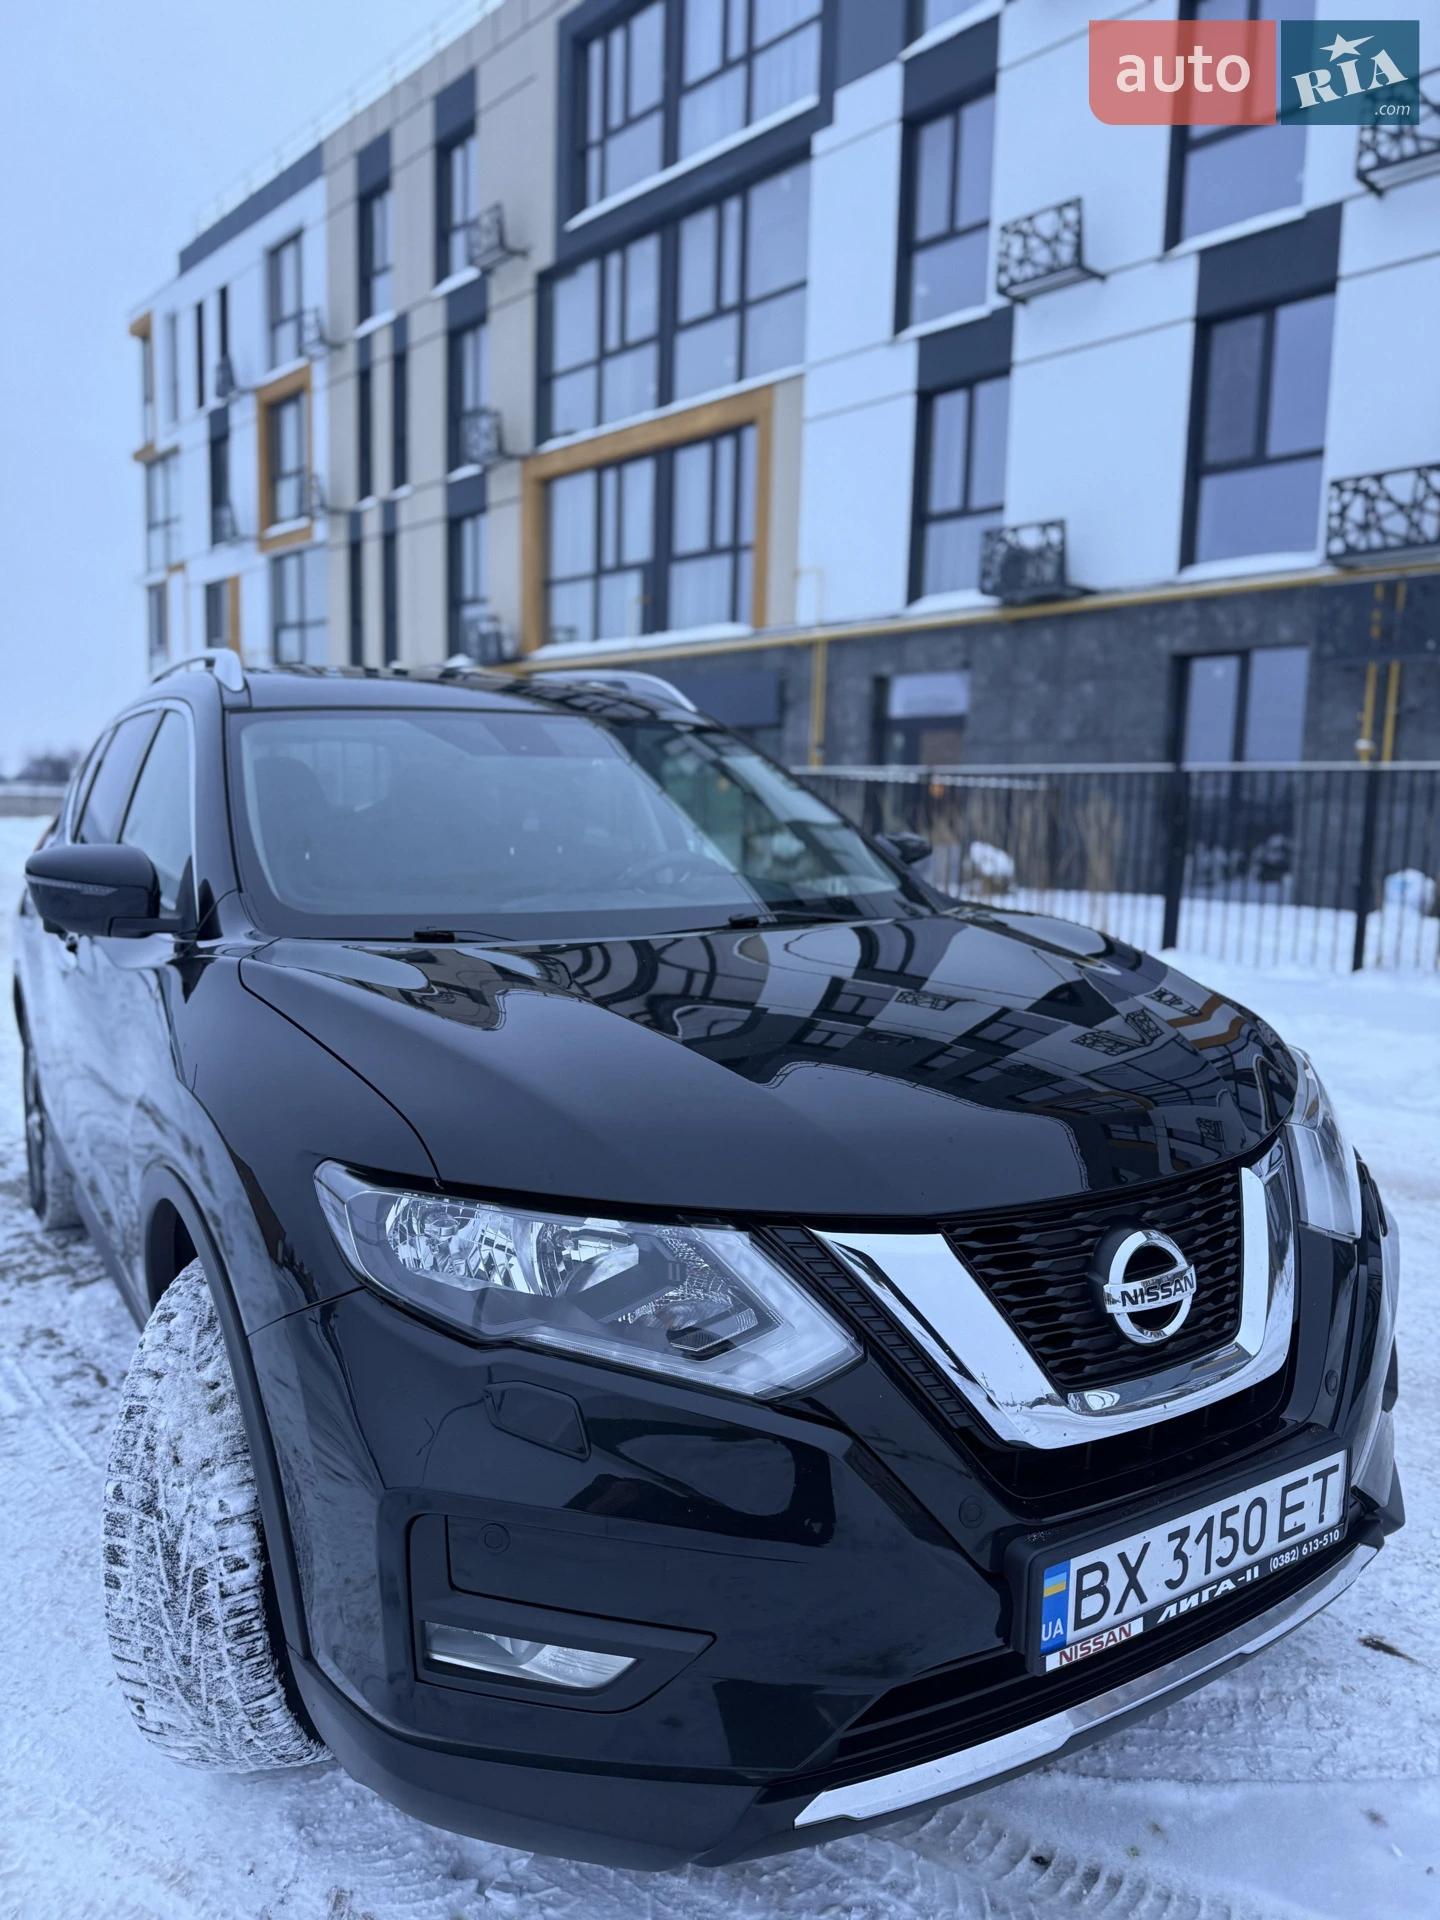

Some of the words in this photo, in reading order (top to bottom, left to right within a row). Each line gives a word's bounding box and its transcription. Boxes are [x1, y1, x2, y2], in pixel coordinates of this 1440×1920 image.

[1120, 1272, 1194, 1307] NISSAN
[1073, 1541, 1151, 1631] BX
[1164, 1496, 1268, 1590] 3150
[1278, 1463, 1340, 1543] ET
[1269, 1546, 1299, 1572] (0382)
[1302, 1529, 1340, 1556] 613-510
[1041, 1617, 1064, 1642] UA
[1059, 1623, 1132, 1666] NISSAN
